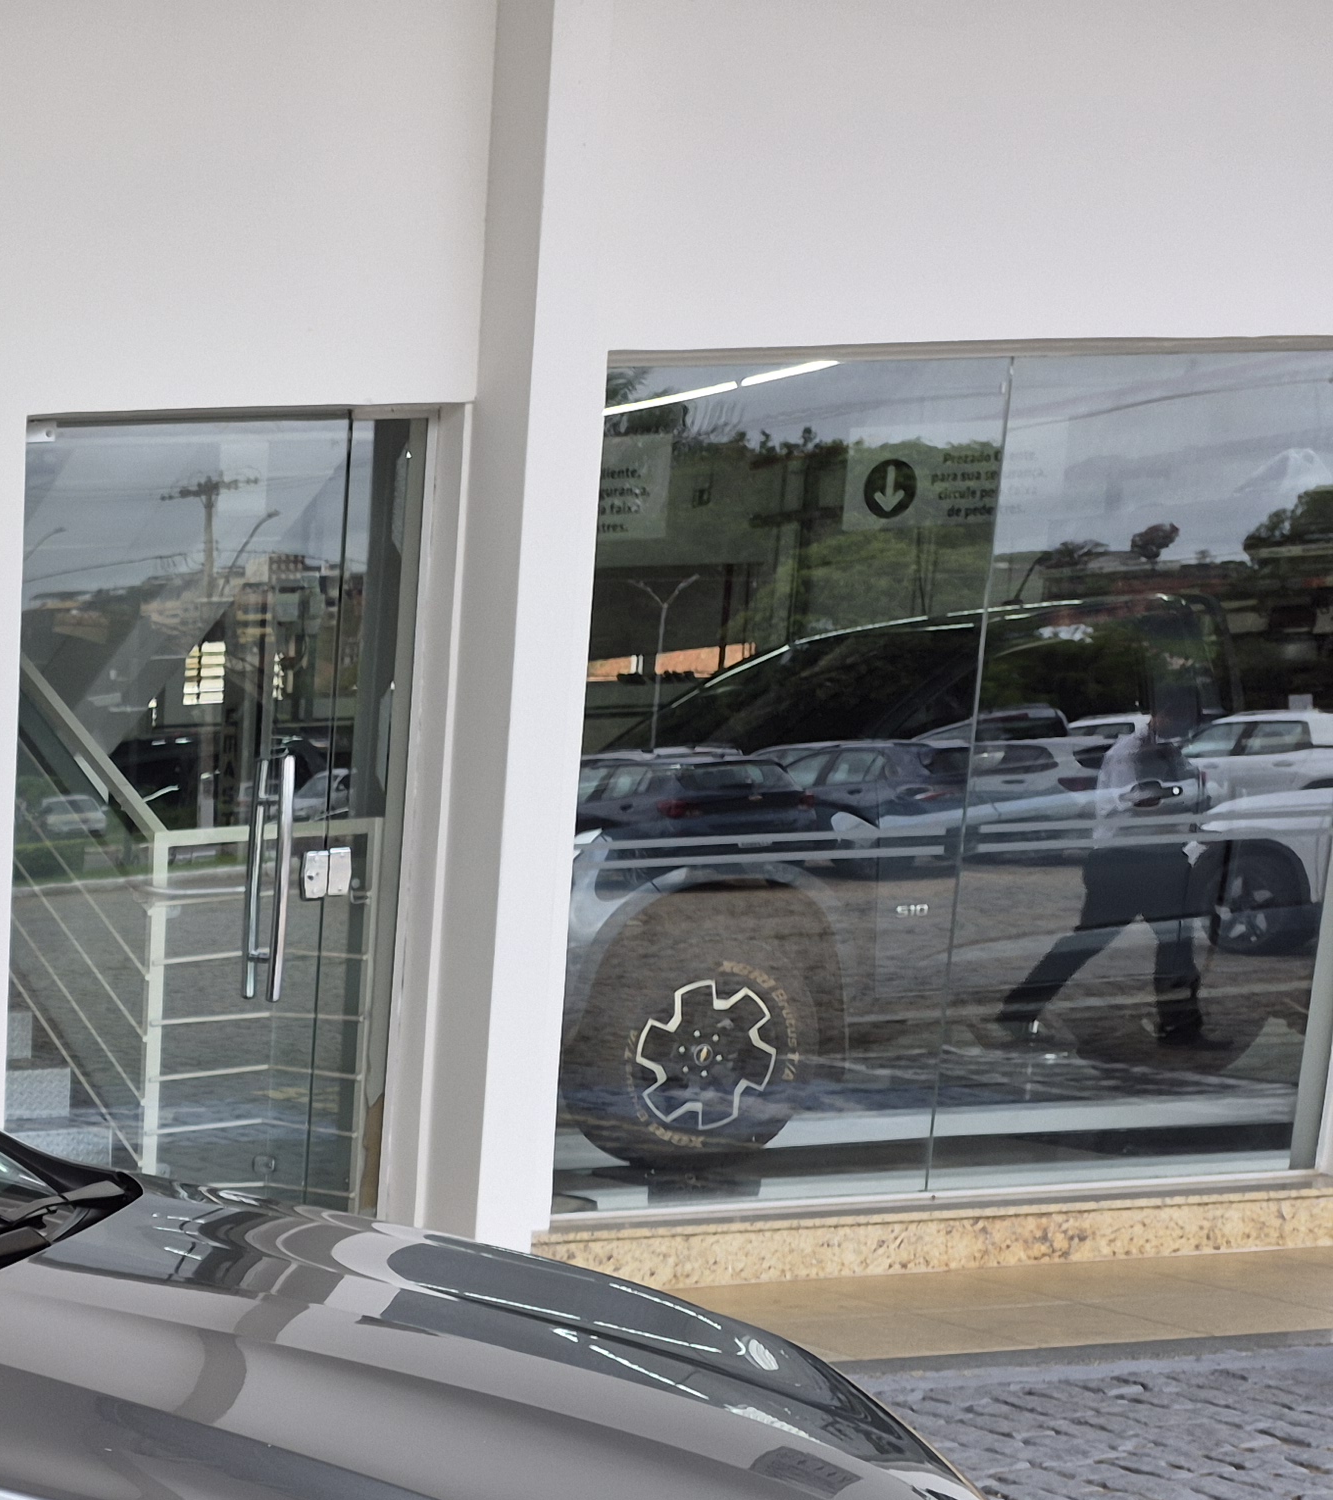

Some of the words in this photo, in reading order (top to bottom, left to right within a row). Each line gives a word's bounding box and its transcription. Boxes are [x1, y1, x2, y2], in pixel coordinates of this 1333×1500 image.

[931, 472, 958, 485] para
[961, 472, 981, 481] sua
[895, 903, 929, 918] S10
